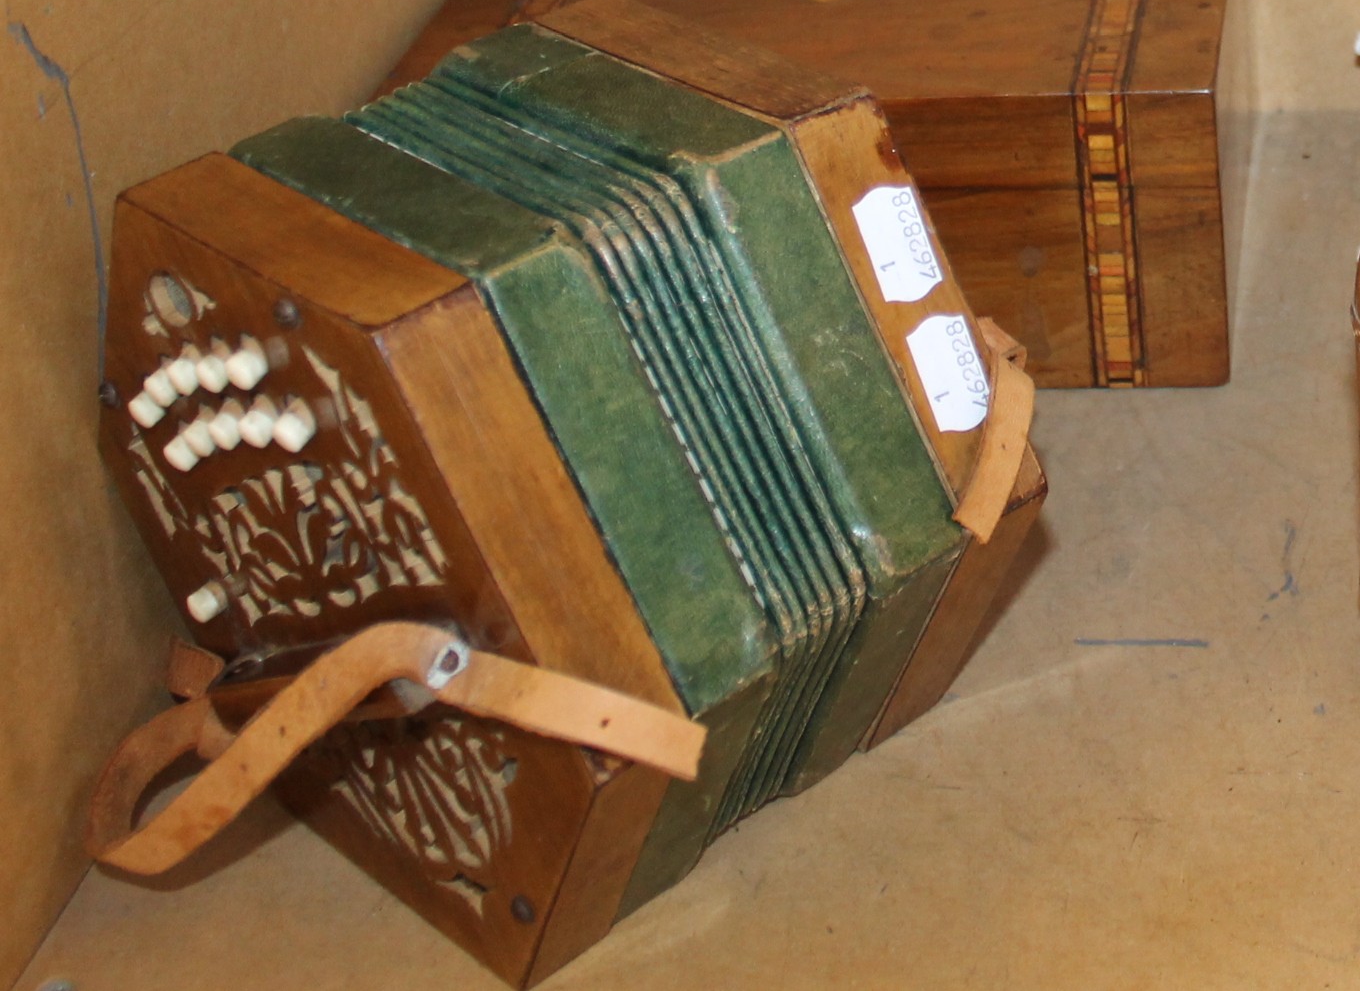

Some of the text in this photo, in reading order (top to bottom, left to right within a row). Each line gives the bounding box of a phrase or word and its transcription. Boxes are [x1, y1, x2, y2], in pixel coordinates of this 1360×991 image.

[891, 191, 938, 279] 462828
[879, 260, 895, 272] 1
[933, 390, 950, 403] 1
